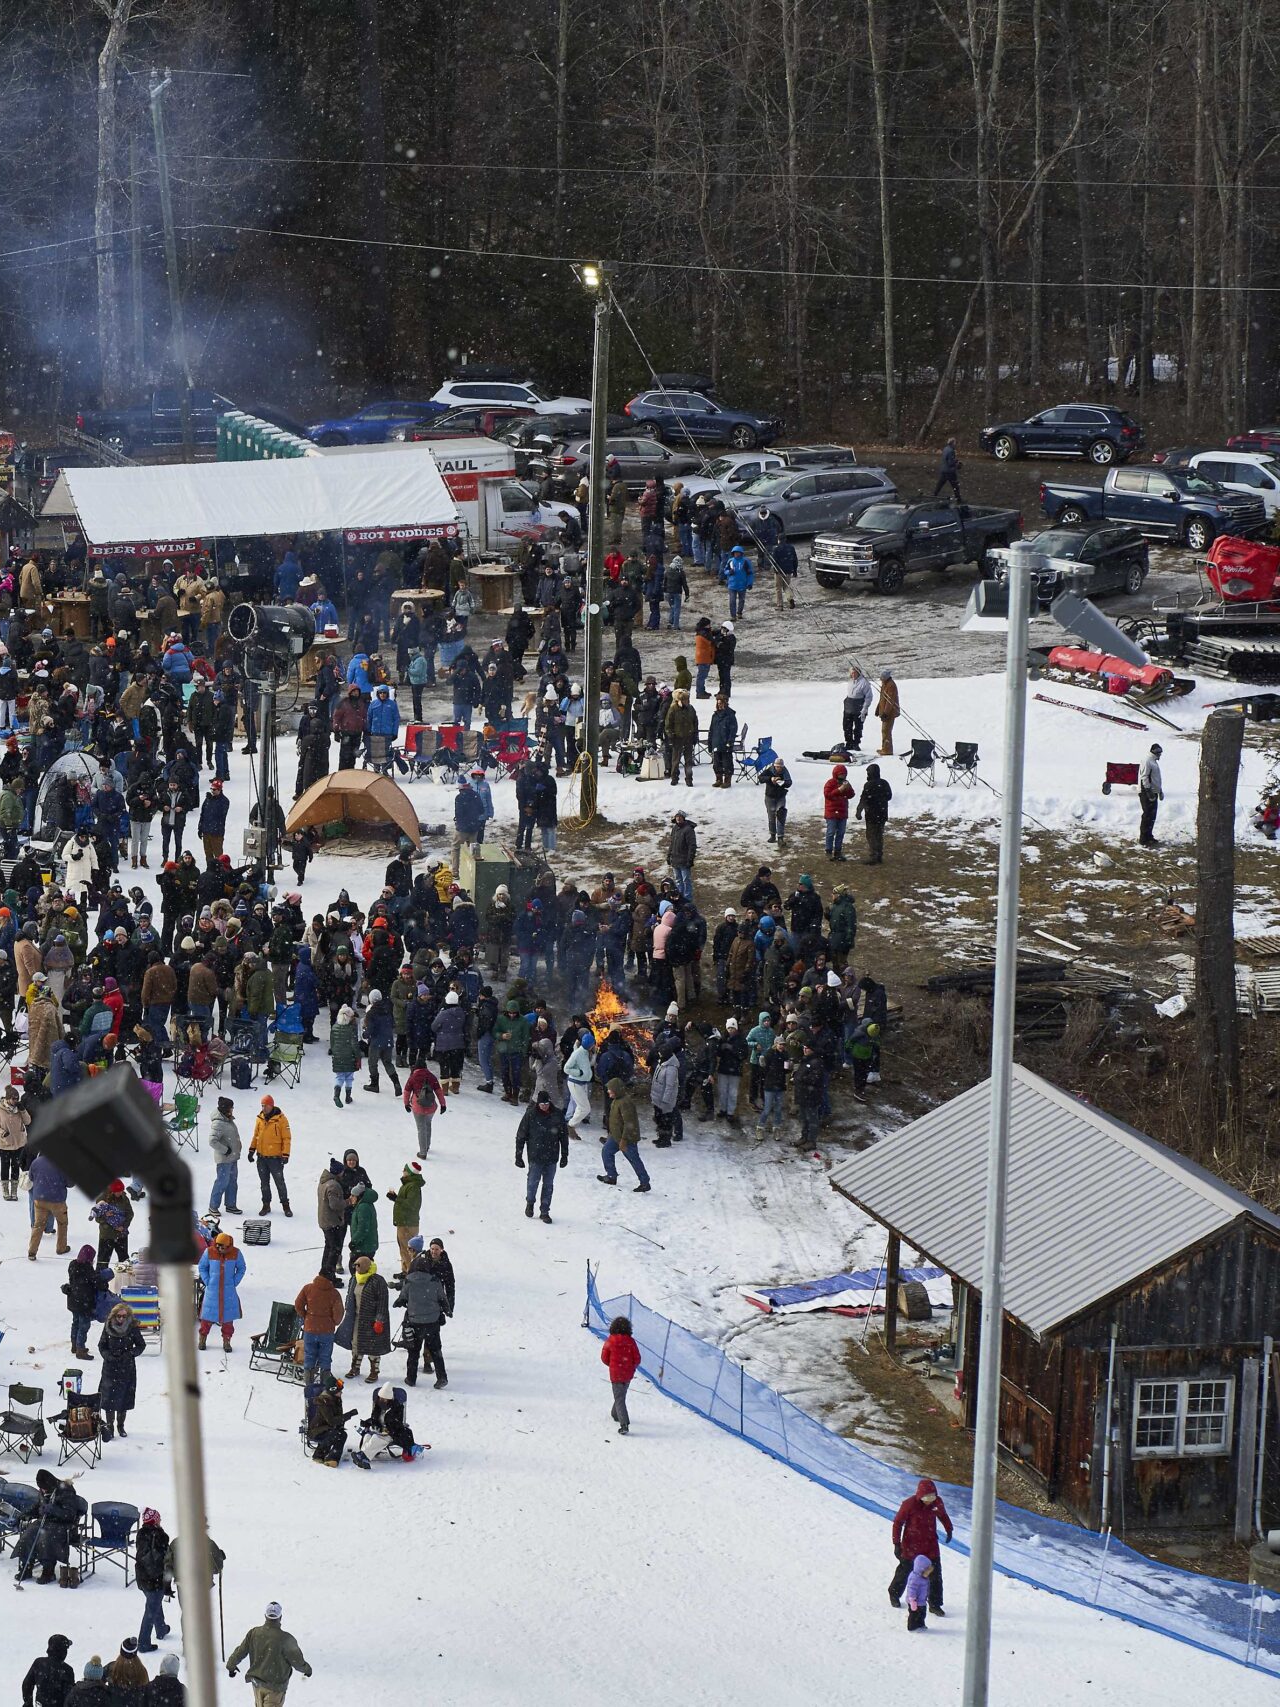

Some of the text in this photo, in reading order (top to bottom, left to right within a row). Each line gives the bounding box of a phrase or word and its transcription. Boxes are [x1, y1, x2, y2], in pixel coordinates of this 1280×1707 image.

[359, 527, 444, 540] HOT TODDIES
[91, 542, 196, 555] BEER WINE
